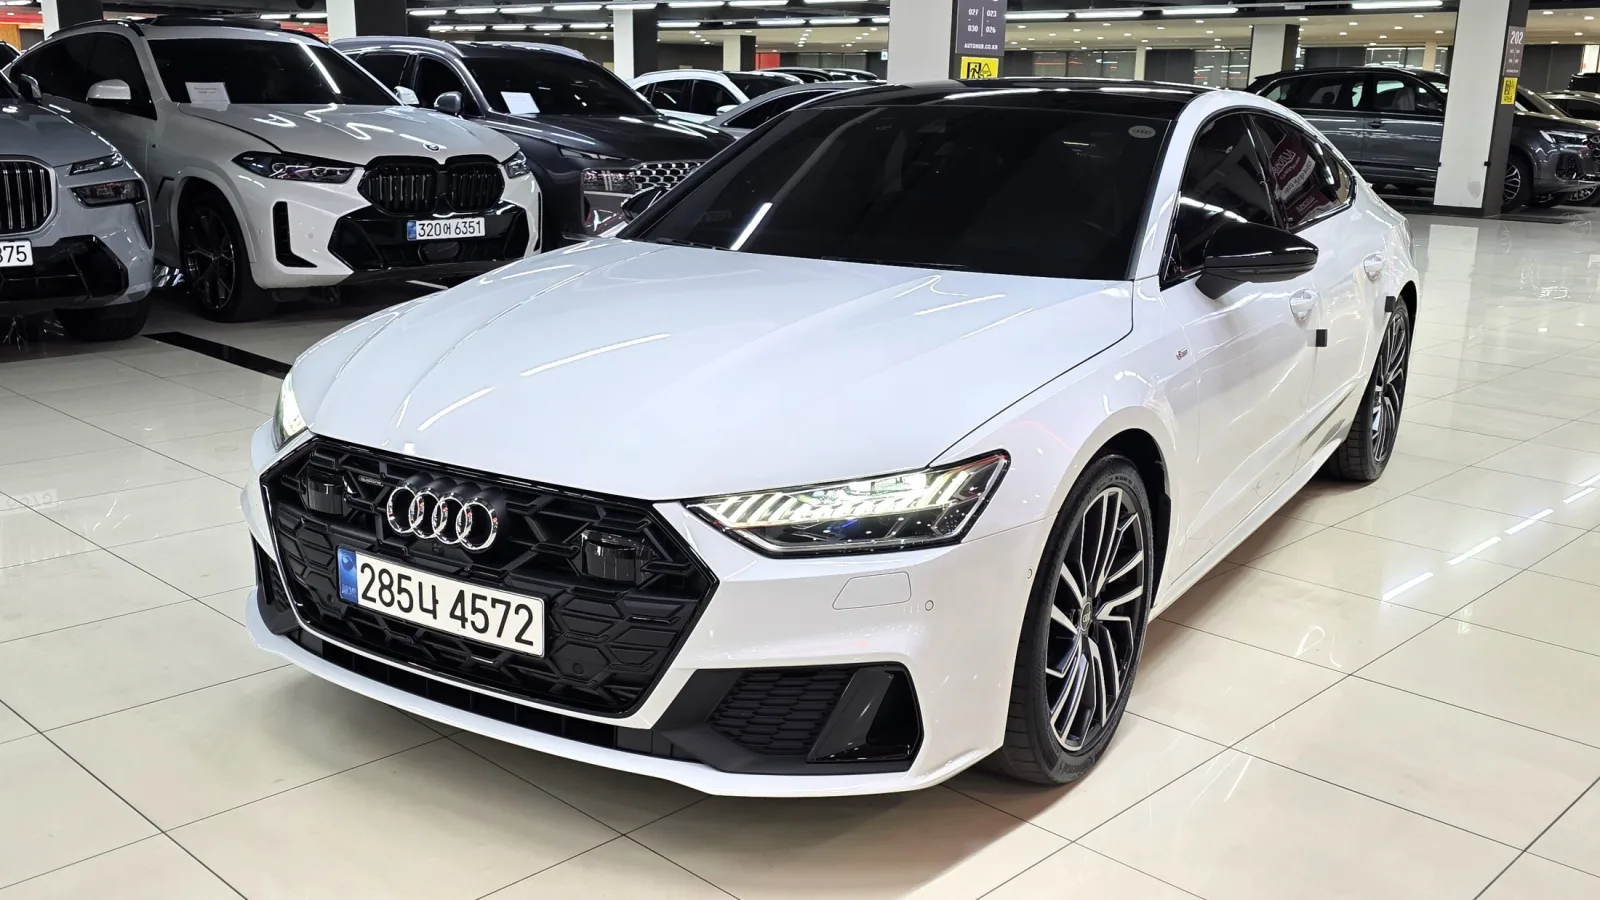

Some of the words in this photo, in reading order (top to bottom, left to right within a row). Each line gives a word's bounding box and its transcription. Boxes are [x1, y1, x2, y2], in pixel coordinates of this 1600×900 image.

[968, 8, 979, 16] 027
[986, 9, 997, 17] 023
[967, 24, 979, 32] 030
[1510, 30, 1523, 44] 202
[418, 222, 452, 237] 320어
[454, 220, 481, 236] 6351
[0, 245, 27, 263] 75
[360, 562, 439, 620] 285나
[449, 589, 534, 647] 4572
